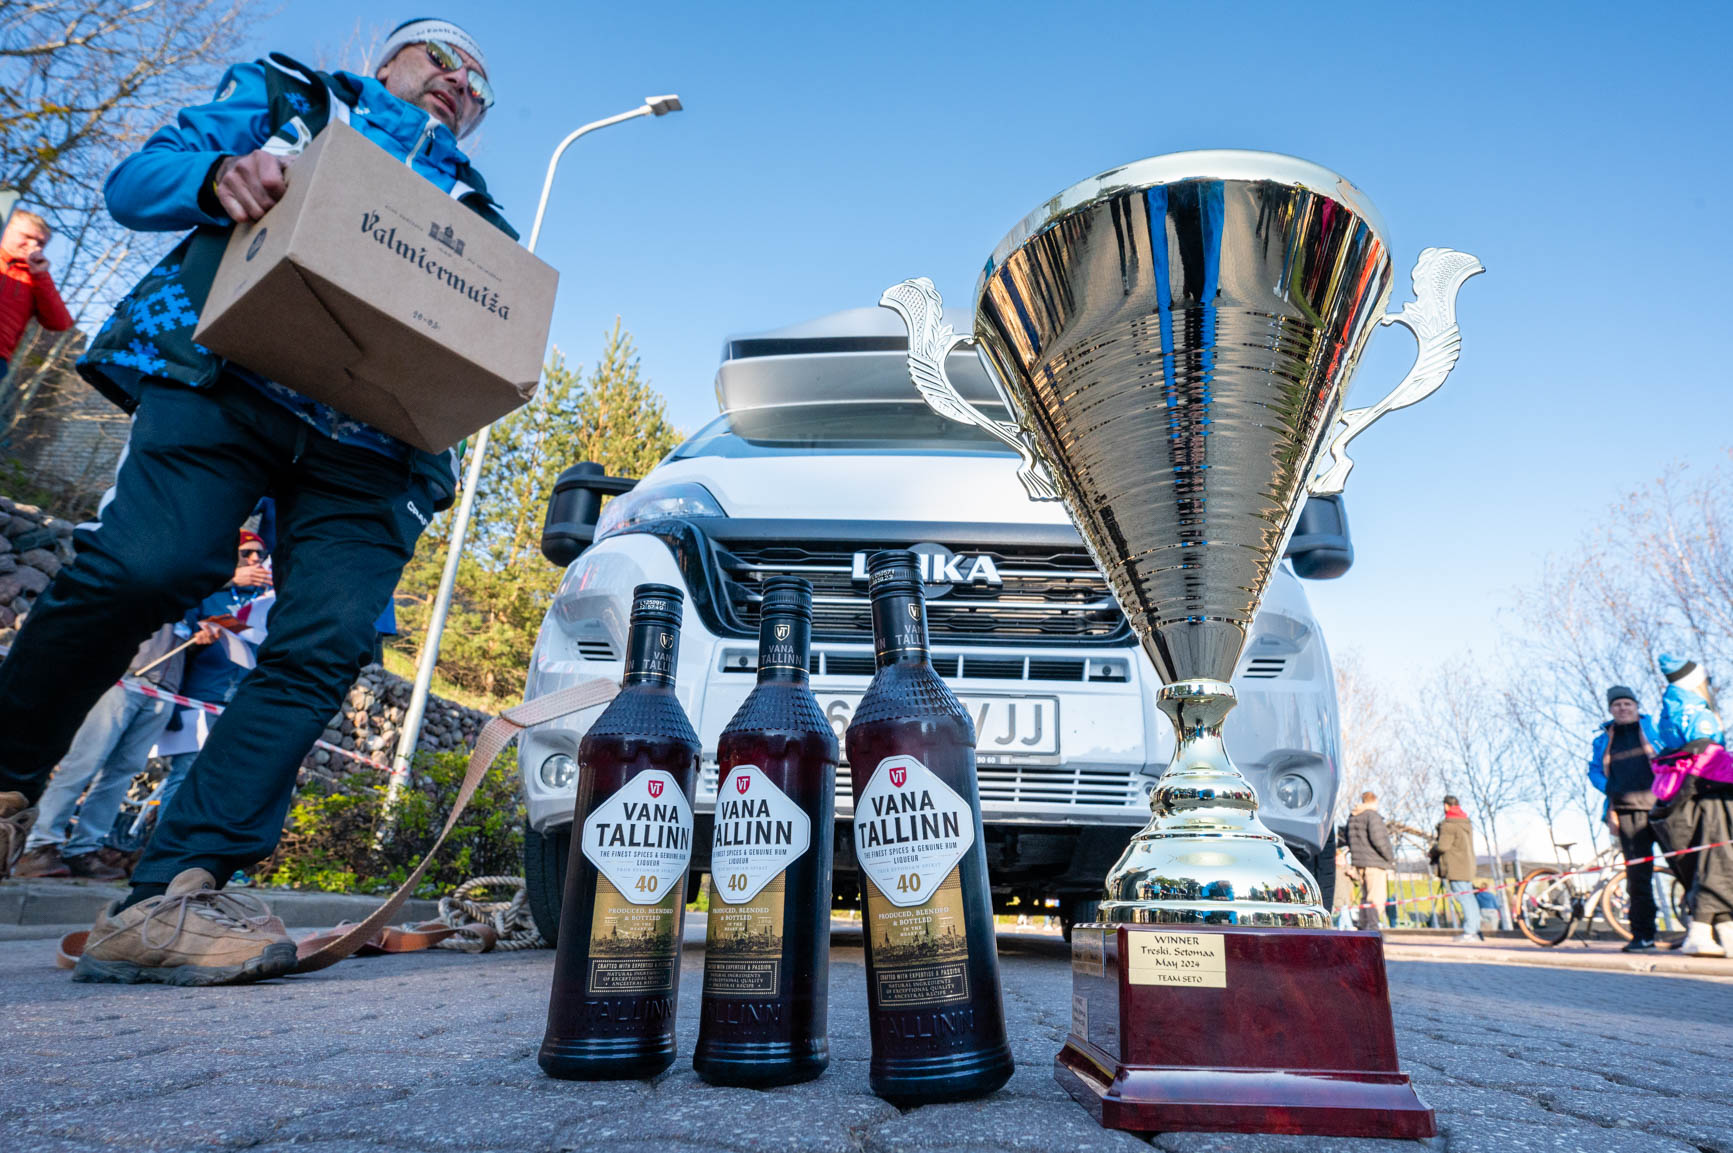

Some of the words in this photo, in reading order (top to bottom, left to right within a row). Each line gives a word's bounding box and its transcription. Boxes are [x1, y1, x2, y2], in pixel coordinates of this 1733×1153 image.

[361, 209, 510, 320] Valmiermuiža
[852, 552, 1002, 582] LIKA
[905, 624, 922, 634] VAN
[895, 634, 924, 646] TALLI
[769, 645, 794, 653] VANA
[761, 654, 802, 665] TALLINN
[891, 770, 904, 783] VT
[650, 782, 662, 795] VT
[738, 779, 749, 790] VT
[722, 799, 771, 820] VANA
[871, 790, 935, 817] VANA
[623, 802, 680, 824] VANA
[859, 811, 960, 849] TALLINN
[596, 824, 690, 851] TALLINN
[872, 849, 887, 858] FINEST
[889, 846, 909, 856] SPICES
[917, 843, 943, 852] GENUINE
[893, 855, 919, 864] LIQUEUR
[635, 875, 658, 892] 40
[728, 874, 747, 891] 40
[897, 873, 921, 893] 40
[916, 907, 949, 916] BLENDED
[900, 917, 932, 926] BOTTLED
[1154, 936, 1200, 945] WINNER
[1174, 948, 1215, 957] Setomaa
[1156, 959, 1178, 969] May
